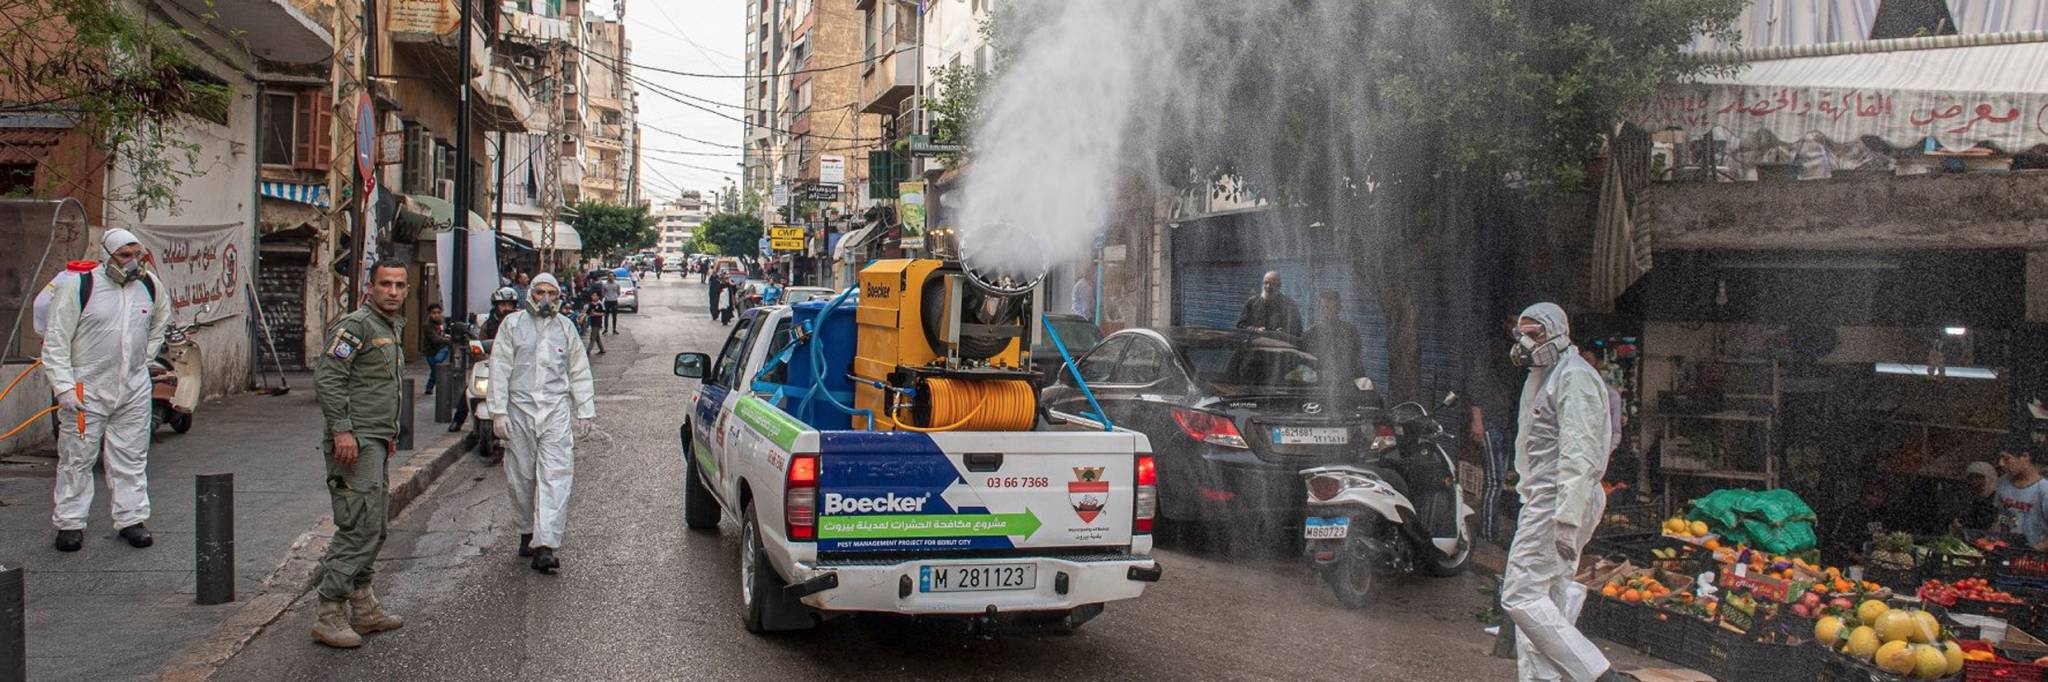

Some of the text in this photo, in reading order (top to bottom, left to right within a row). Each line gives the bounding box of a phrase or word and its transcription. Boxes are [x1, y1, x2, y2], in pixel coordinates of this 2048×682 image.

[1715, 85, 2019, 134] معرض الفاكهة والخضار
[867, 281, 890, 298] Boecker
[986, 477, 1049, 488] 03 66 7368
[825, 492, 927, 515] Boecker
[824, 517, 1006, 533] مشروع مكافحة الحشرات لمدينة بيروت
[1306, 527, 1345, 537] M860723
[934, 567, 1024, 588] M 281123
